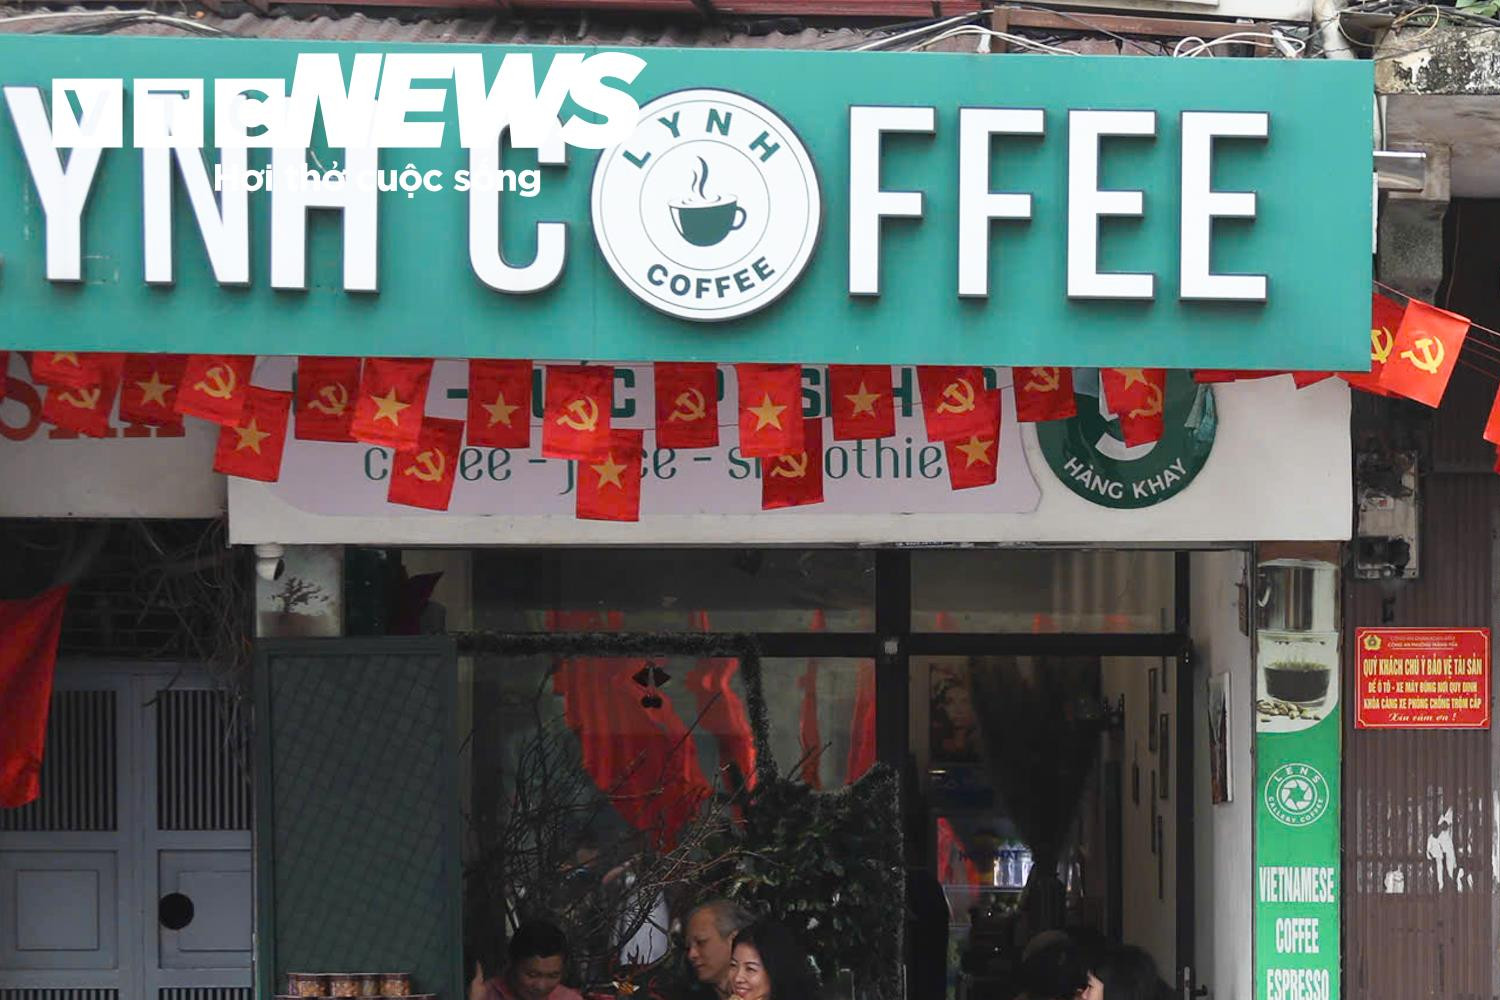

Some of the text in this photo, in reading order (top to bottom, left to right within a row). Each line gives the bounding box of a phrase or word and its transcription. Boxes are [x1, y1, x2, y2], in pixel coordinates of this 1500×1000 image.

[622, 108, 780, 169] LYNH
[0, 86, 380, 293] YNH
[647, 256, 775, 299] COFFEE
[1063, 455, 1188, 500] HÀNG KHAY
[1274, 767, 1320, 783] LENS
[1259, 867, 1334, 903] VIETNAMESE
[1276, 918, 1320, 954] COFFEE
